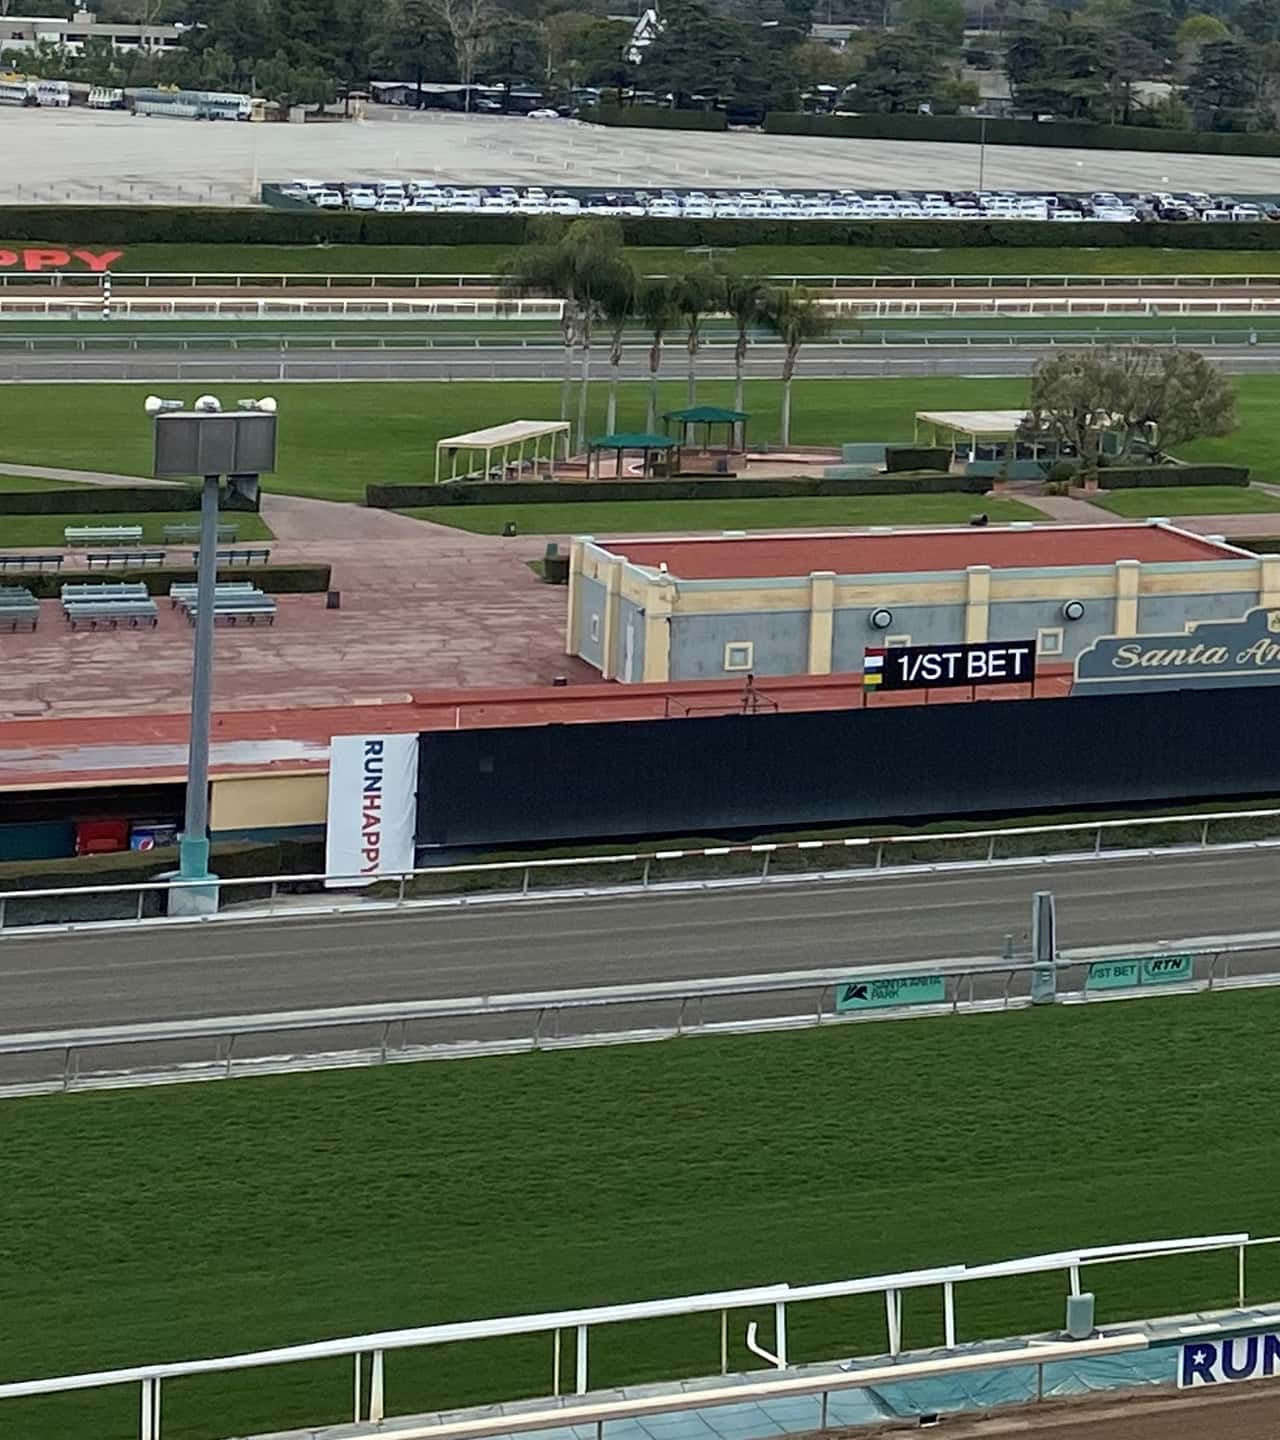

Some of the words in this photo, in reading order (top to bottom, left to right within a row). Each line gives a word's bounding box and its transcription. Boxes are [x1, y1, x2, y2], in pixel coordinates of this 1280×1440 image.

[897, 652, 962, 681] 1/ST
[967, 648, 1029, 678] BET
[1112, 642, 1229, 668] Santa
[1113, 964, 1137, 977] BET
